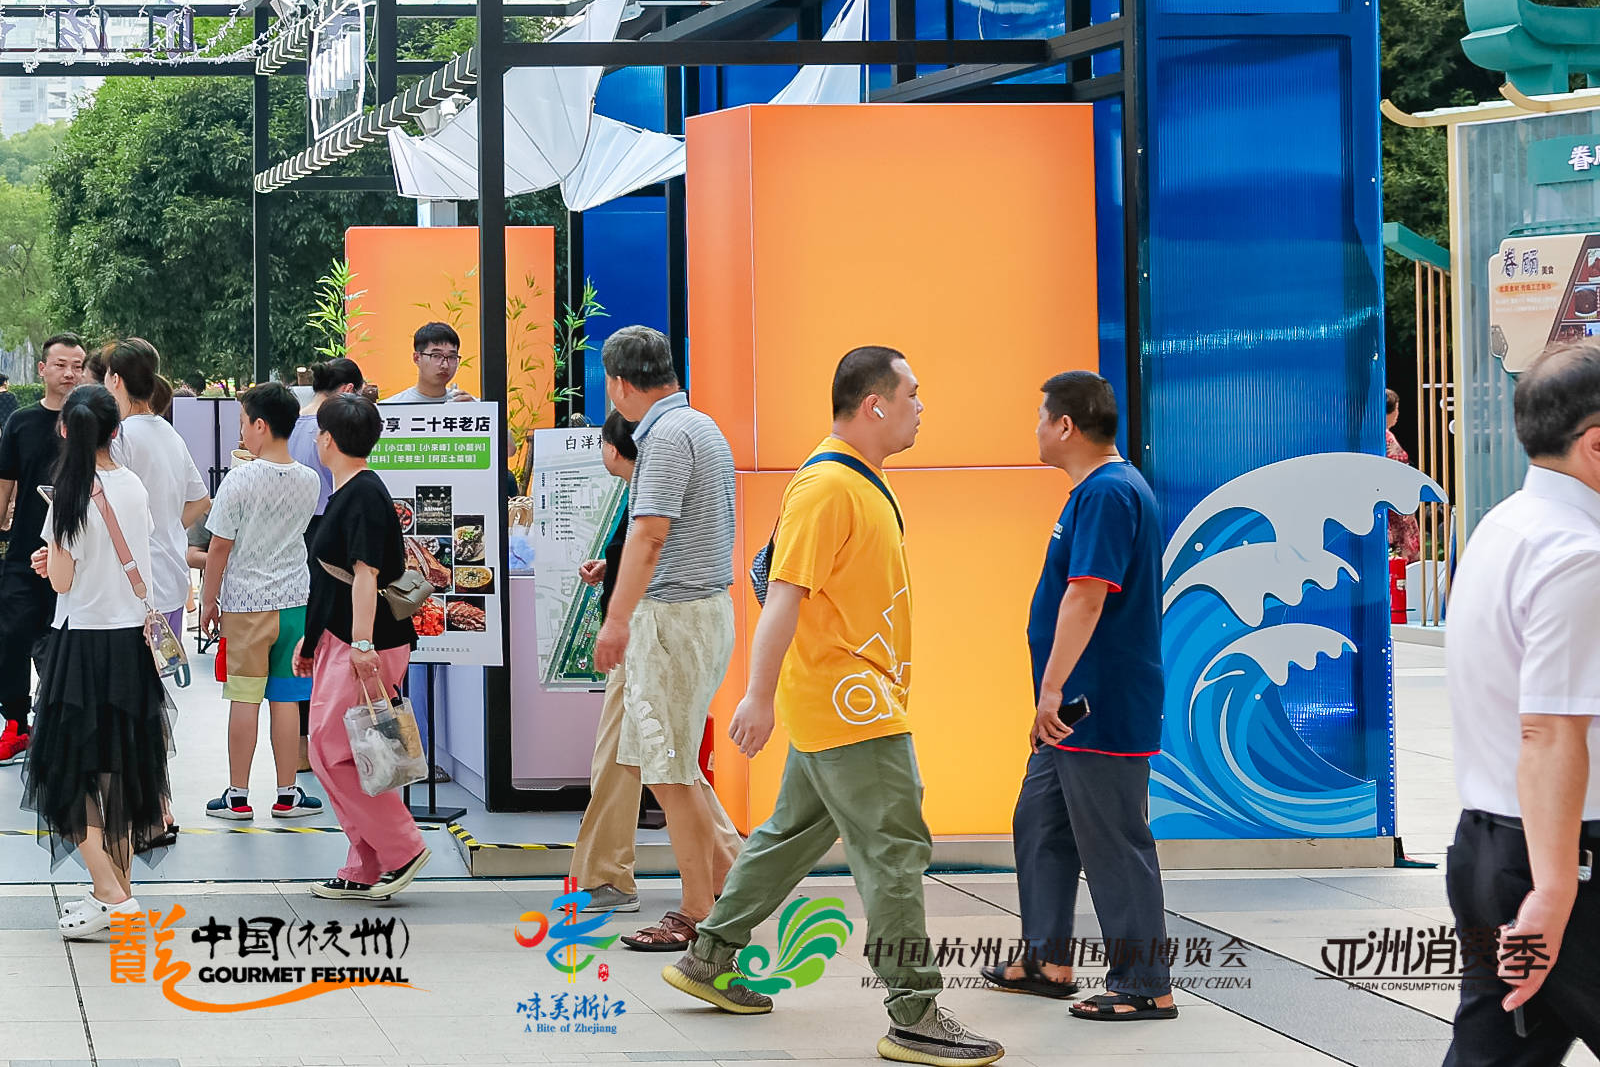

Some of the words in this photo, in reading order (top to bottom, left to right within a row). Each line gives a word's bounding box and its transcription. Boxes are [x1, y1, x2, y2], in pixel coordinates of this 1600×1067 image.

[410, 416, 491, 432] 二十年老店
[565, 434, 603, 451] 白洋
